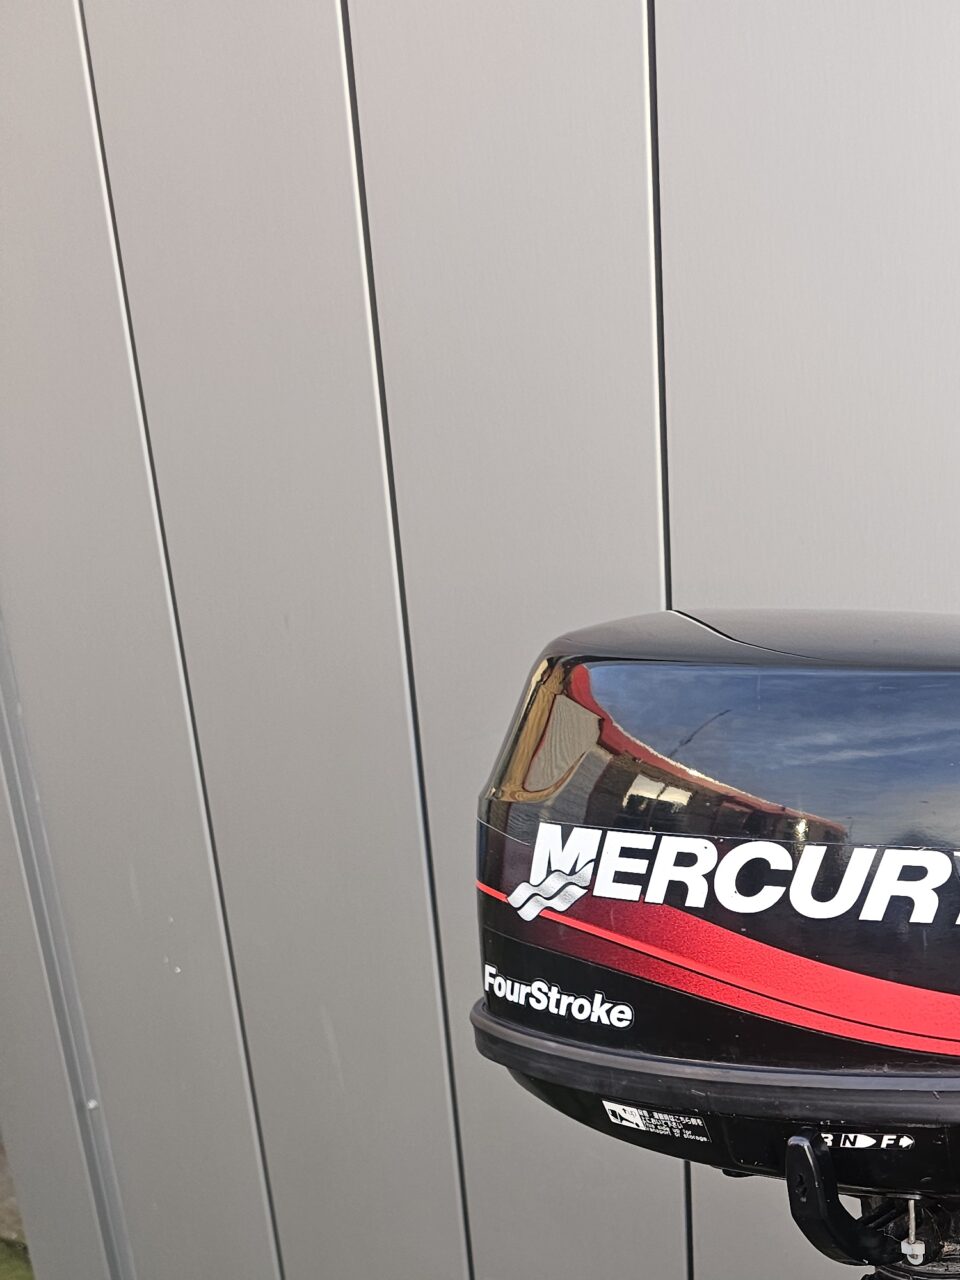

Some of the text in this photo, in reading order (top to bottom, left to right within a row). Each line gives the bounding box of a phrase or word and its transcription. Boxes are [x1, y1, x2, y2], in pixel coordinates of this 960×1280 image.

[485, 964, 633, 1028] FourStroke
[842, 1134, 858, 1147] N
[880, 1134, 897, 1148] F
